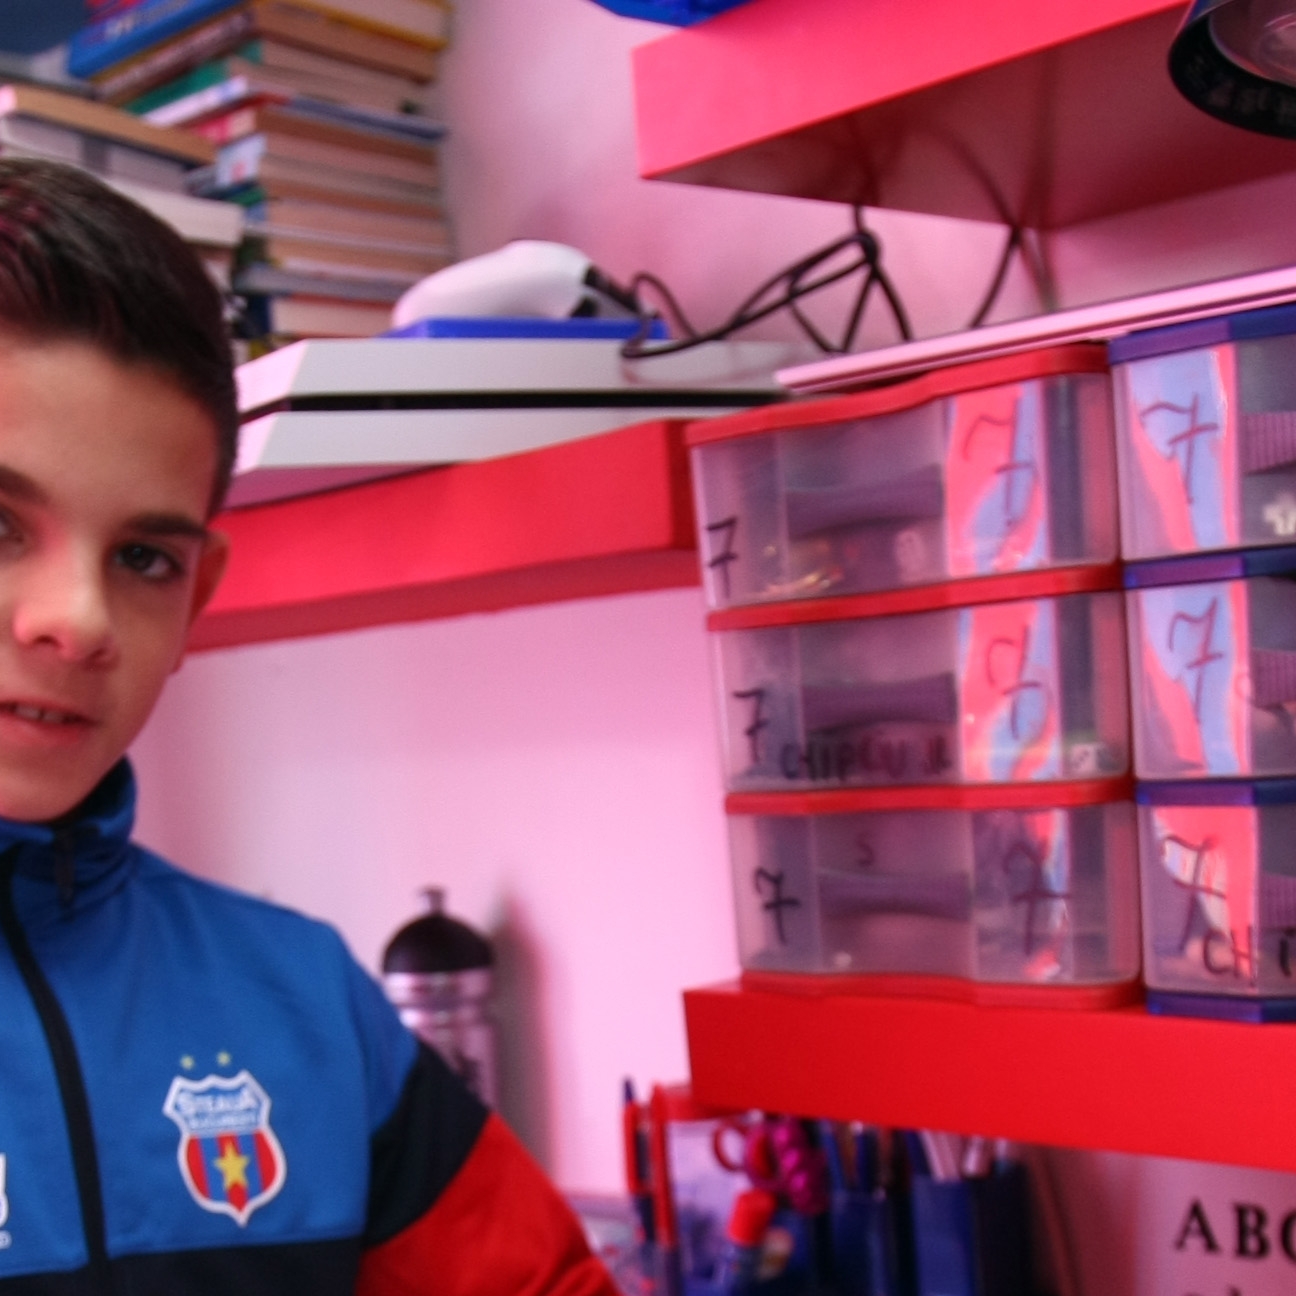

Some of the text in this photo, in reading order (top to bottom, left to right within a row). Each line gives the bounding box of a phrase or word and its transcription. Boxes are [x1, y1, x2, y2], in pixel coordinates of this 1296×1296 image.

[964, 397, 1036, 527] 7
[1140, 392, 1219, 503] 7
[705, 517, 738, 598] 7
[1170, 601, 1223, 722] 7
[733, 687, 768, 766] 7
[755, 867, 801, 943] 7
[1163, 836, 1226, 952] 7
